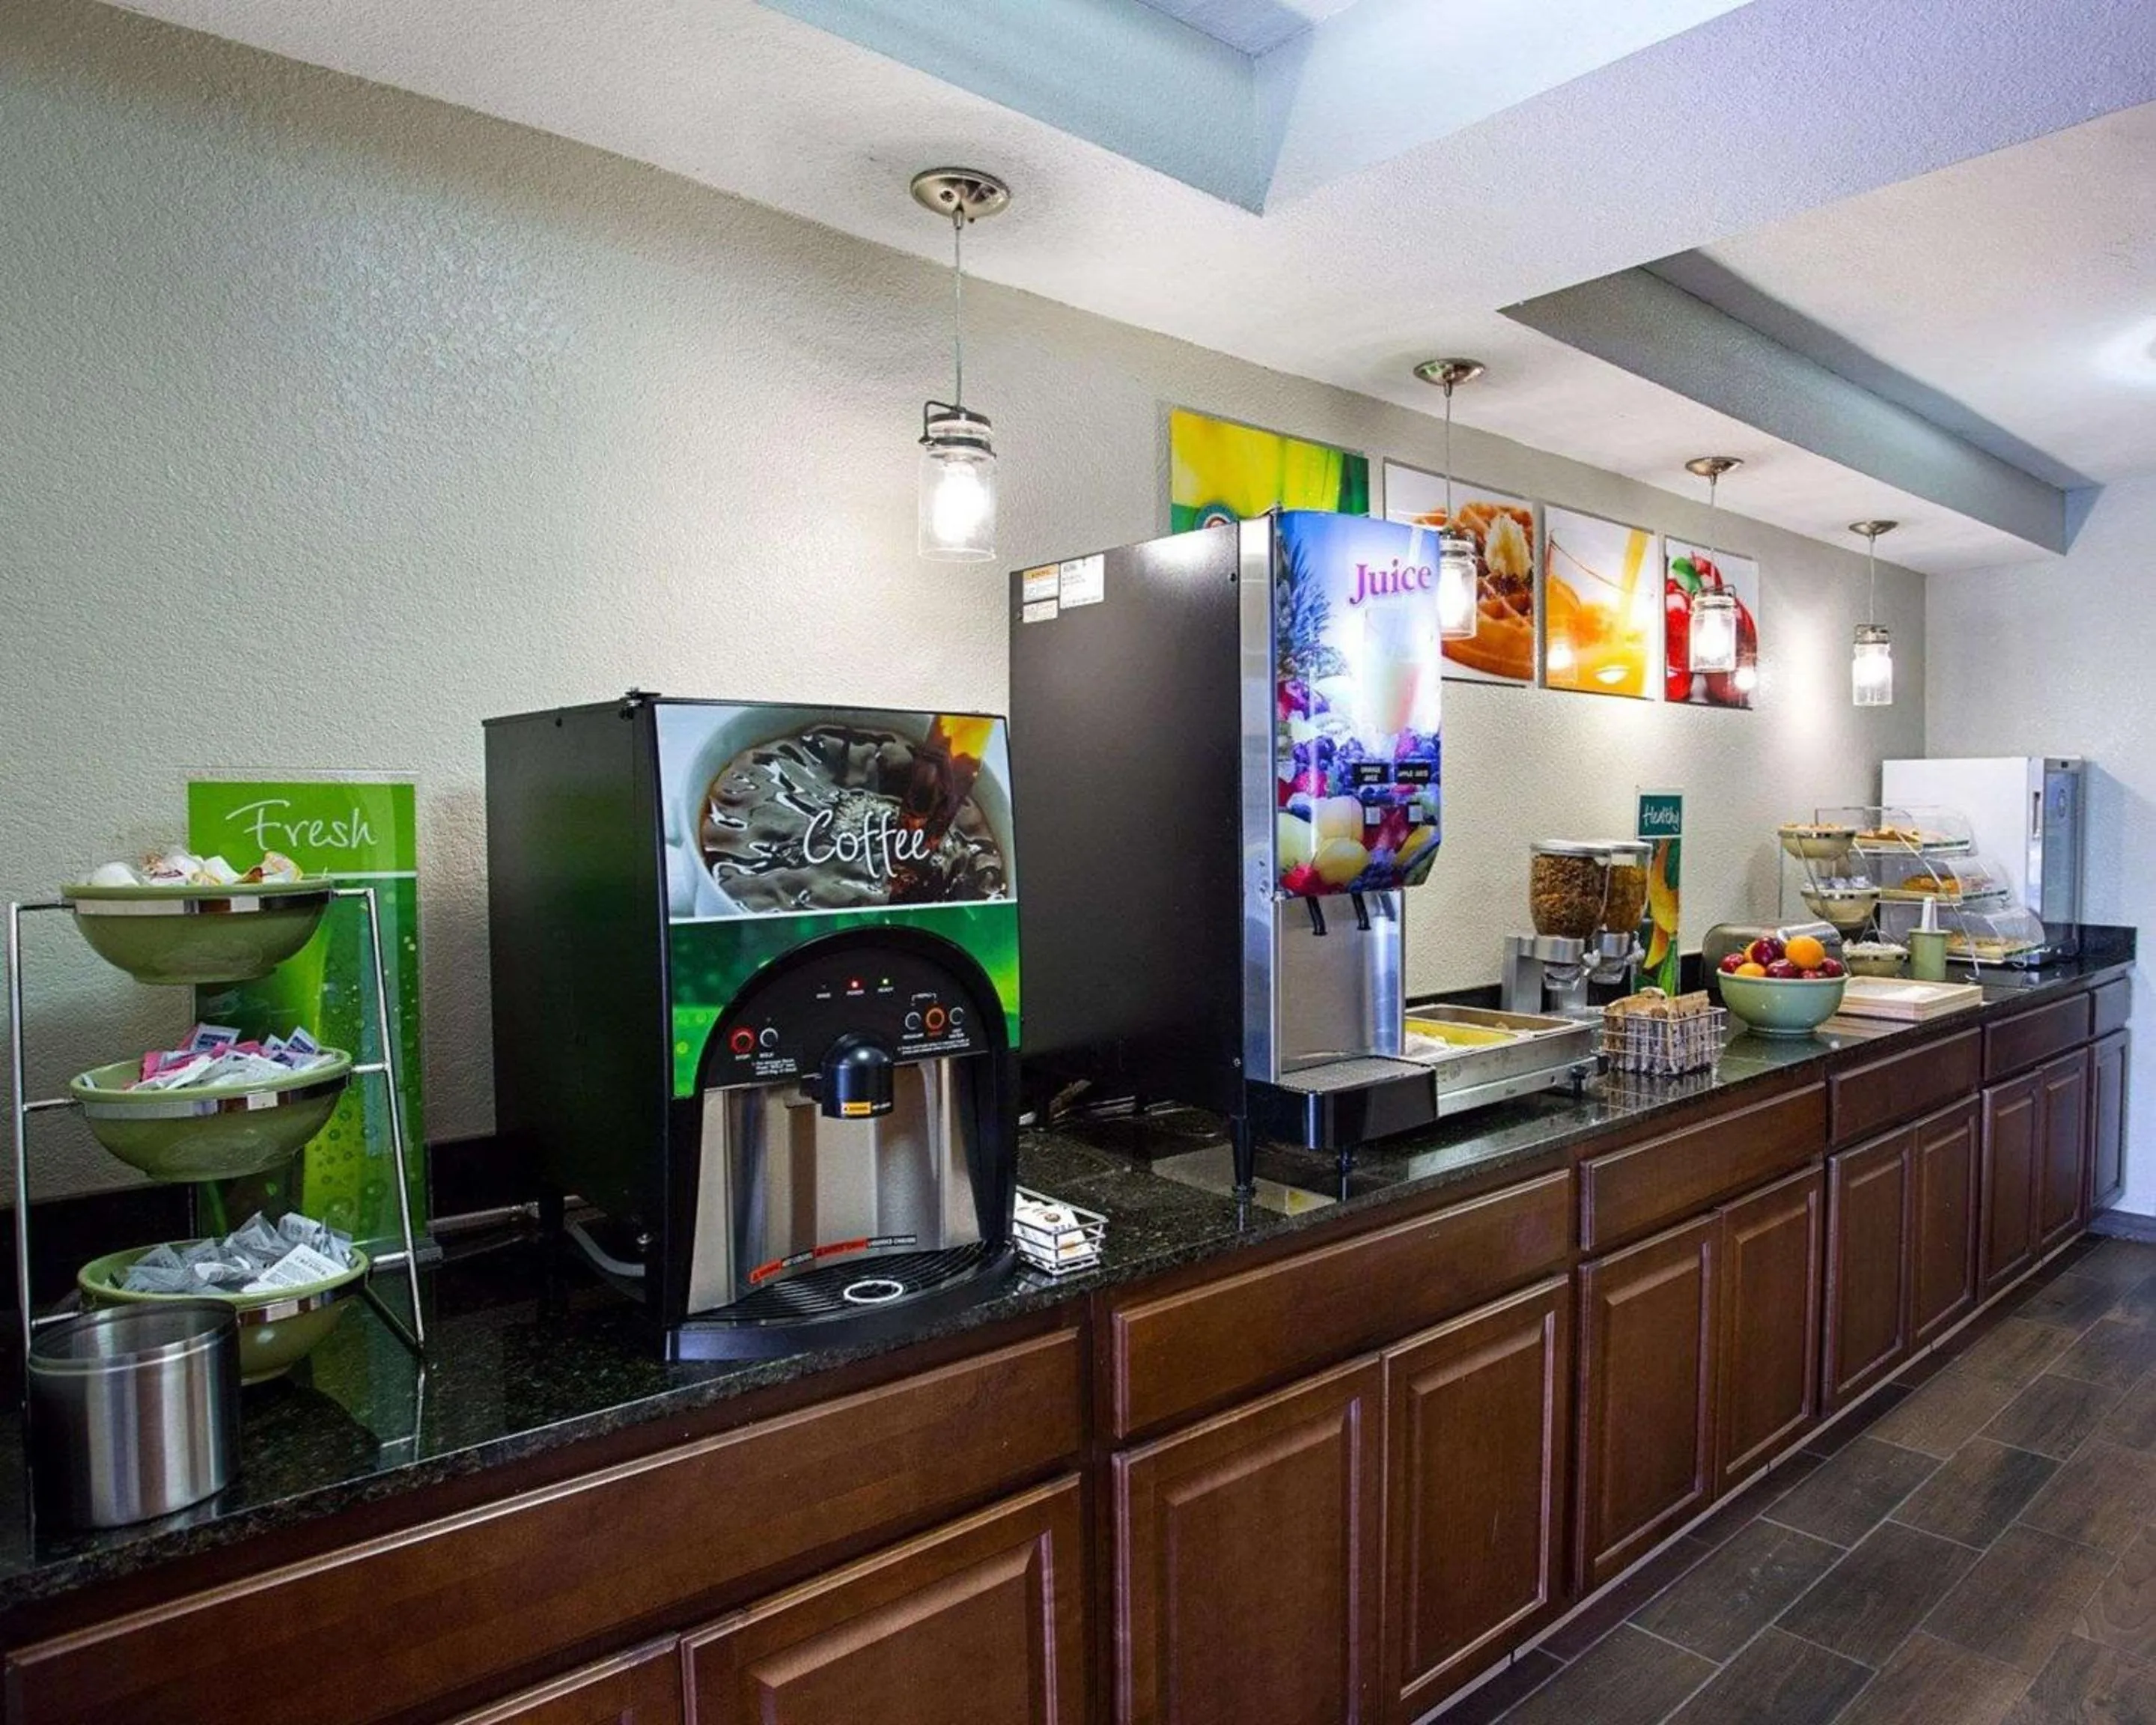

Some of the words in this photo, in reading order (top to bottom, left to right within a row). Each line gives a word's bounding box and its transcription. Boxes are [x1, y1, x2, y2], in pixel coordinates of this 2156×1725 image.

[1349, 558, 1432, 605] Juice
[225, 799, 377, 851] Fresh
[1642, 804, 1680, 833] Healthy
[803, 809, 931, 878] Coffee
